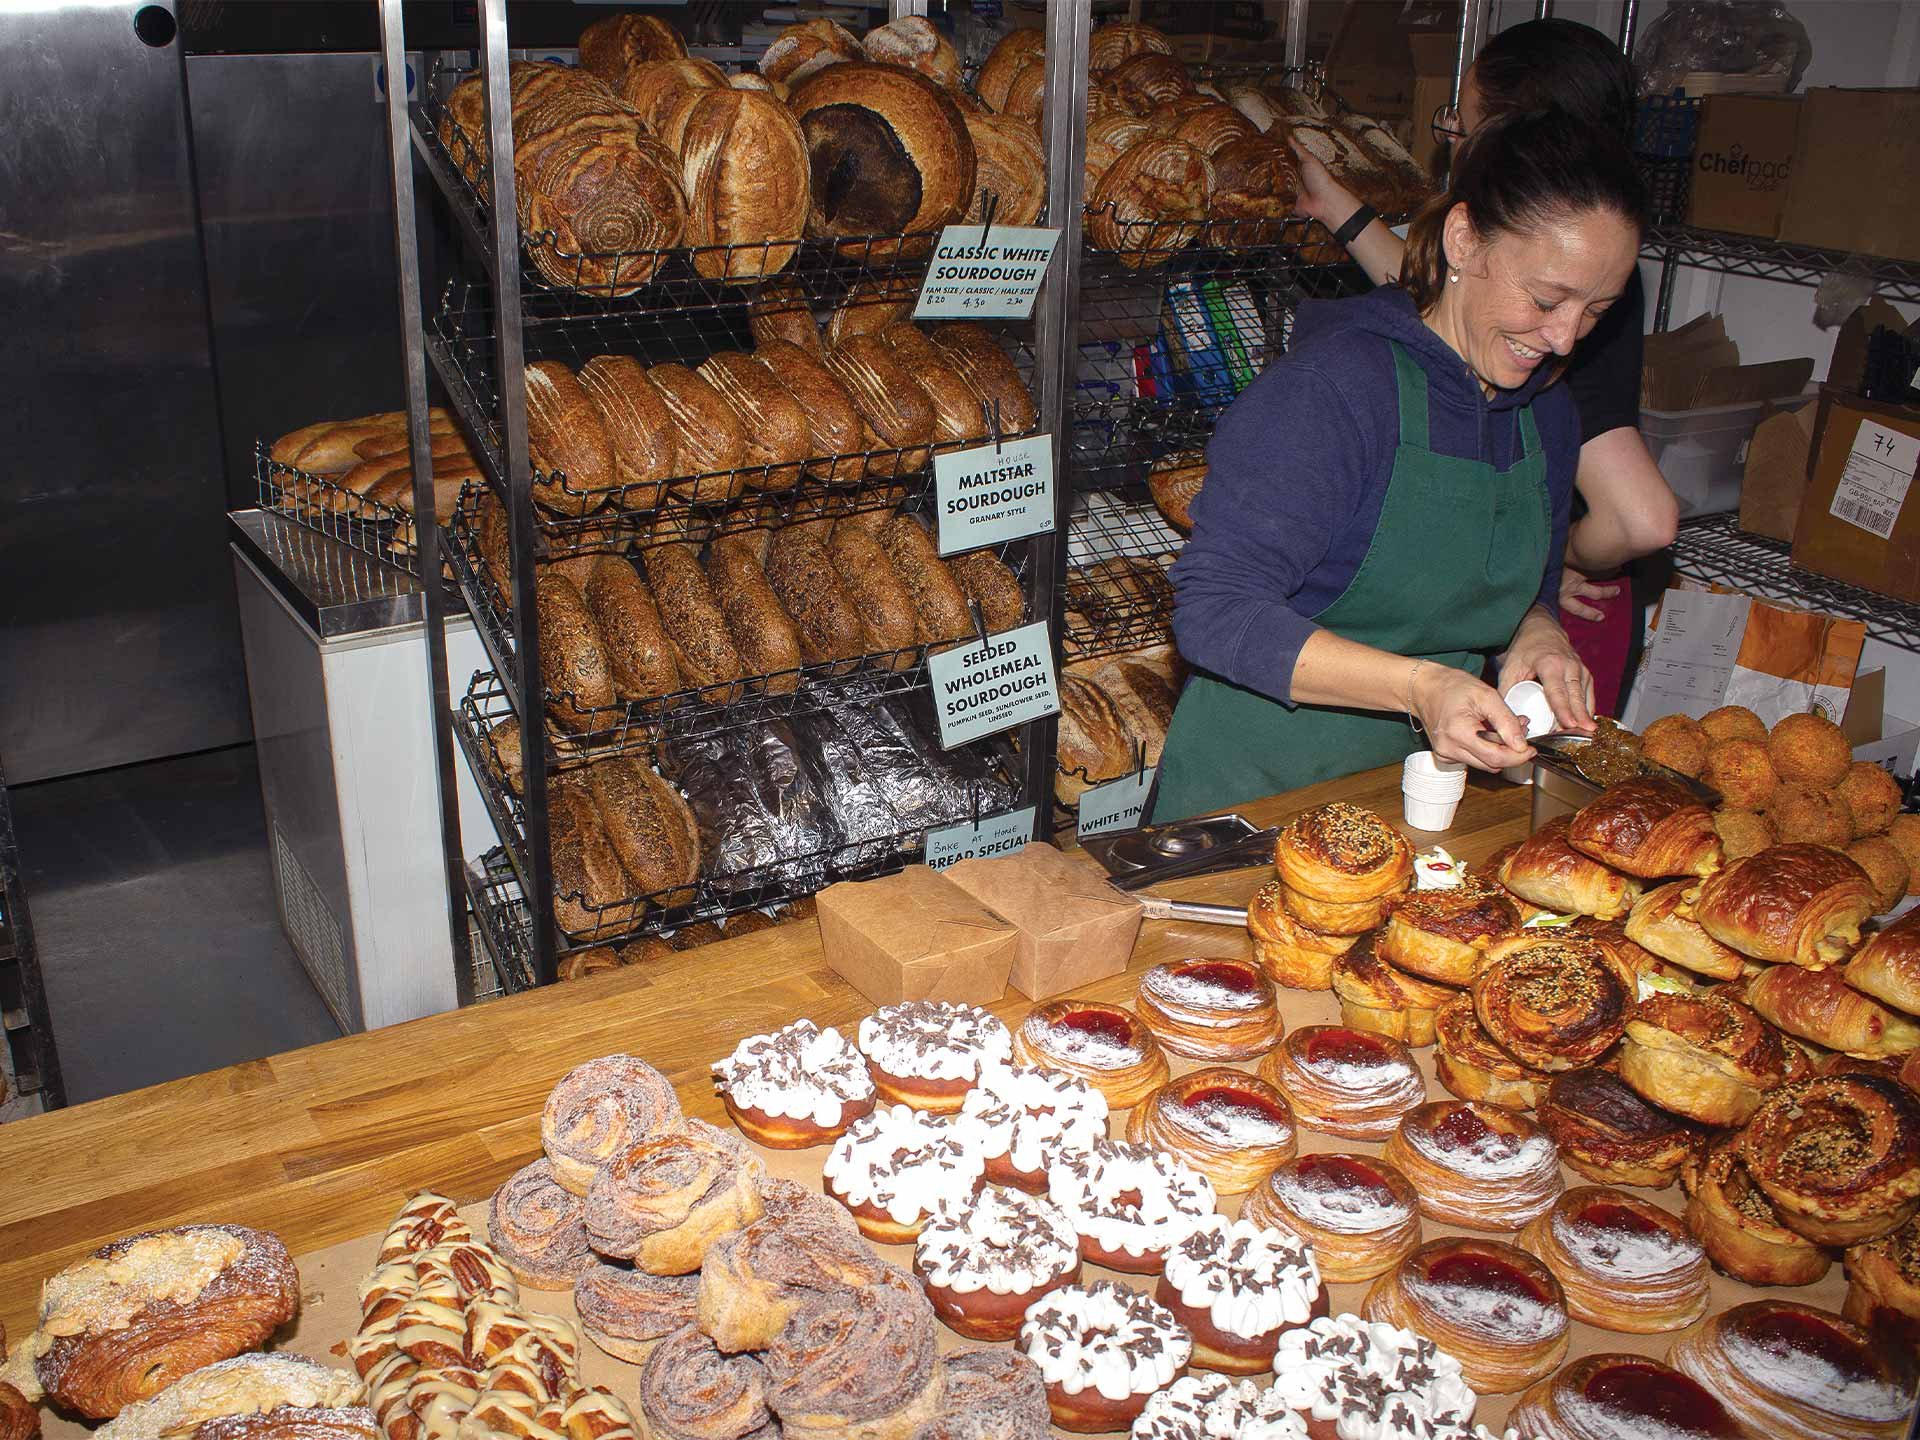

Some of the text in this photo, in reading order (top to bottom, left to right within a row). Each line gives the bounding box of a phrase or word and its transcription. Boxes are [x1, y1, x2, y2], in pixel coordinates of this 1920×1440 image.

[937, 247, 1050, 262] CLASSIC WHITE
[936, 267, 1037, 281] SOURDOUGH
[966, 287, 994, 295] CLASSIC
[1874, 432, 1896, 457] 74
[958, 463, 1034, 490] MALTSTAR
[947, 481, 1046, 514] SOURDOUGH
[969, 507, 1027, 525] GRANARY STYLE
[963, 641, 1017, 668] SEEDED
[945, 654, 1042, 695] WHOLEMEAL
[947, 672, 1047, 716] SOURDOUGH
[947, 714, 977, 729] PUMPKIN
[996, 695, 1033, 712] SUNFLOWER
[988, 710, 1013, 723] LINSEED
[1081, 804, 1142, 832] WHITE TIN
[928, 834, 1030, 869] BREAD SPECIAL
